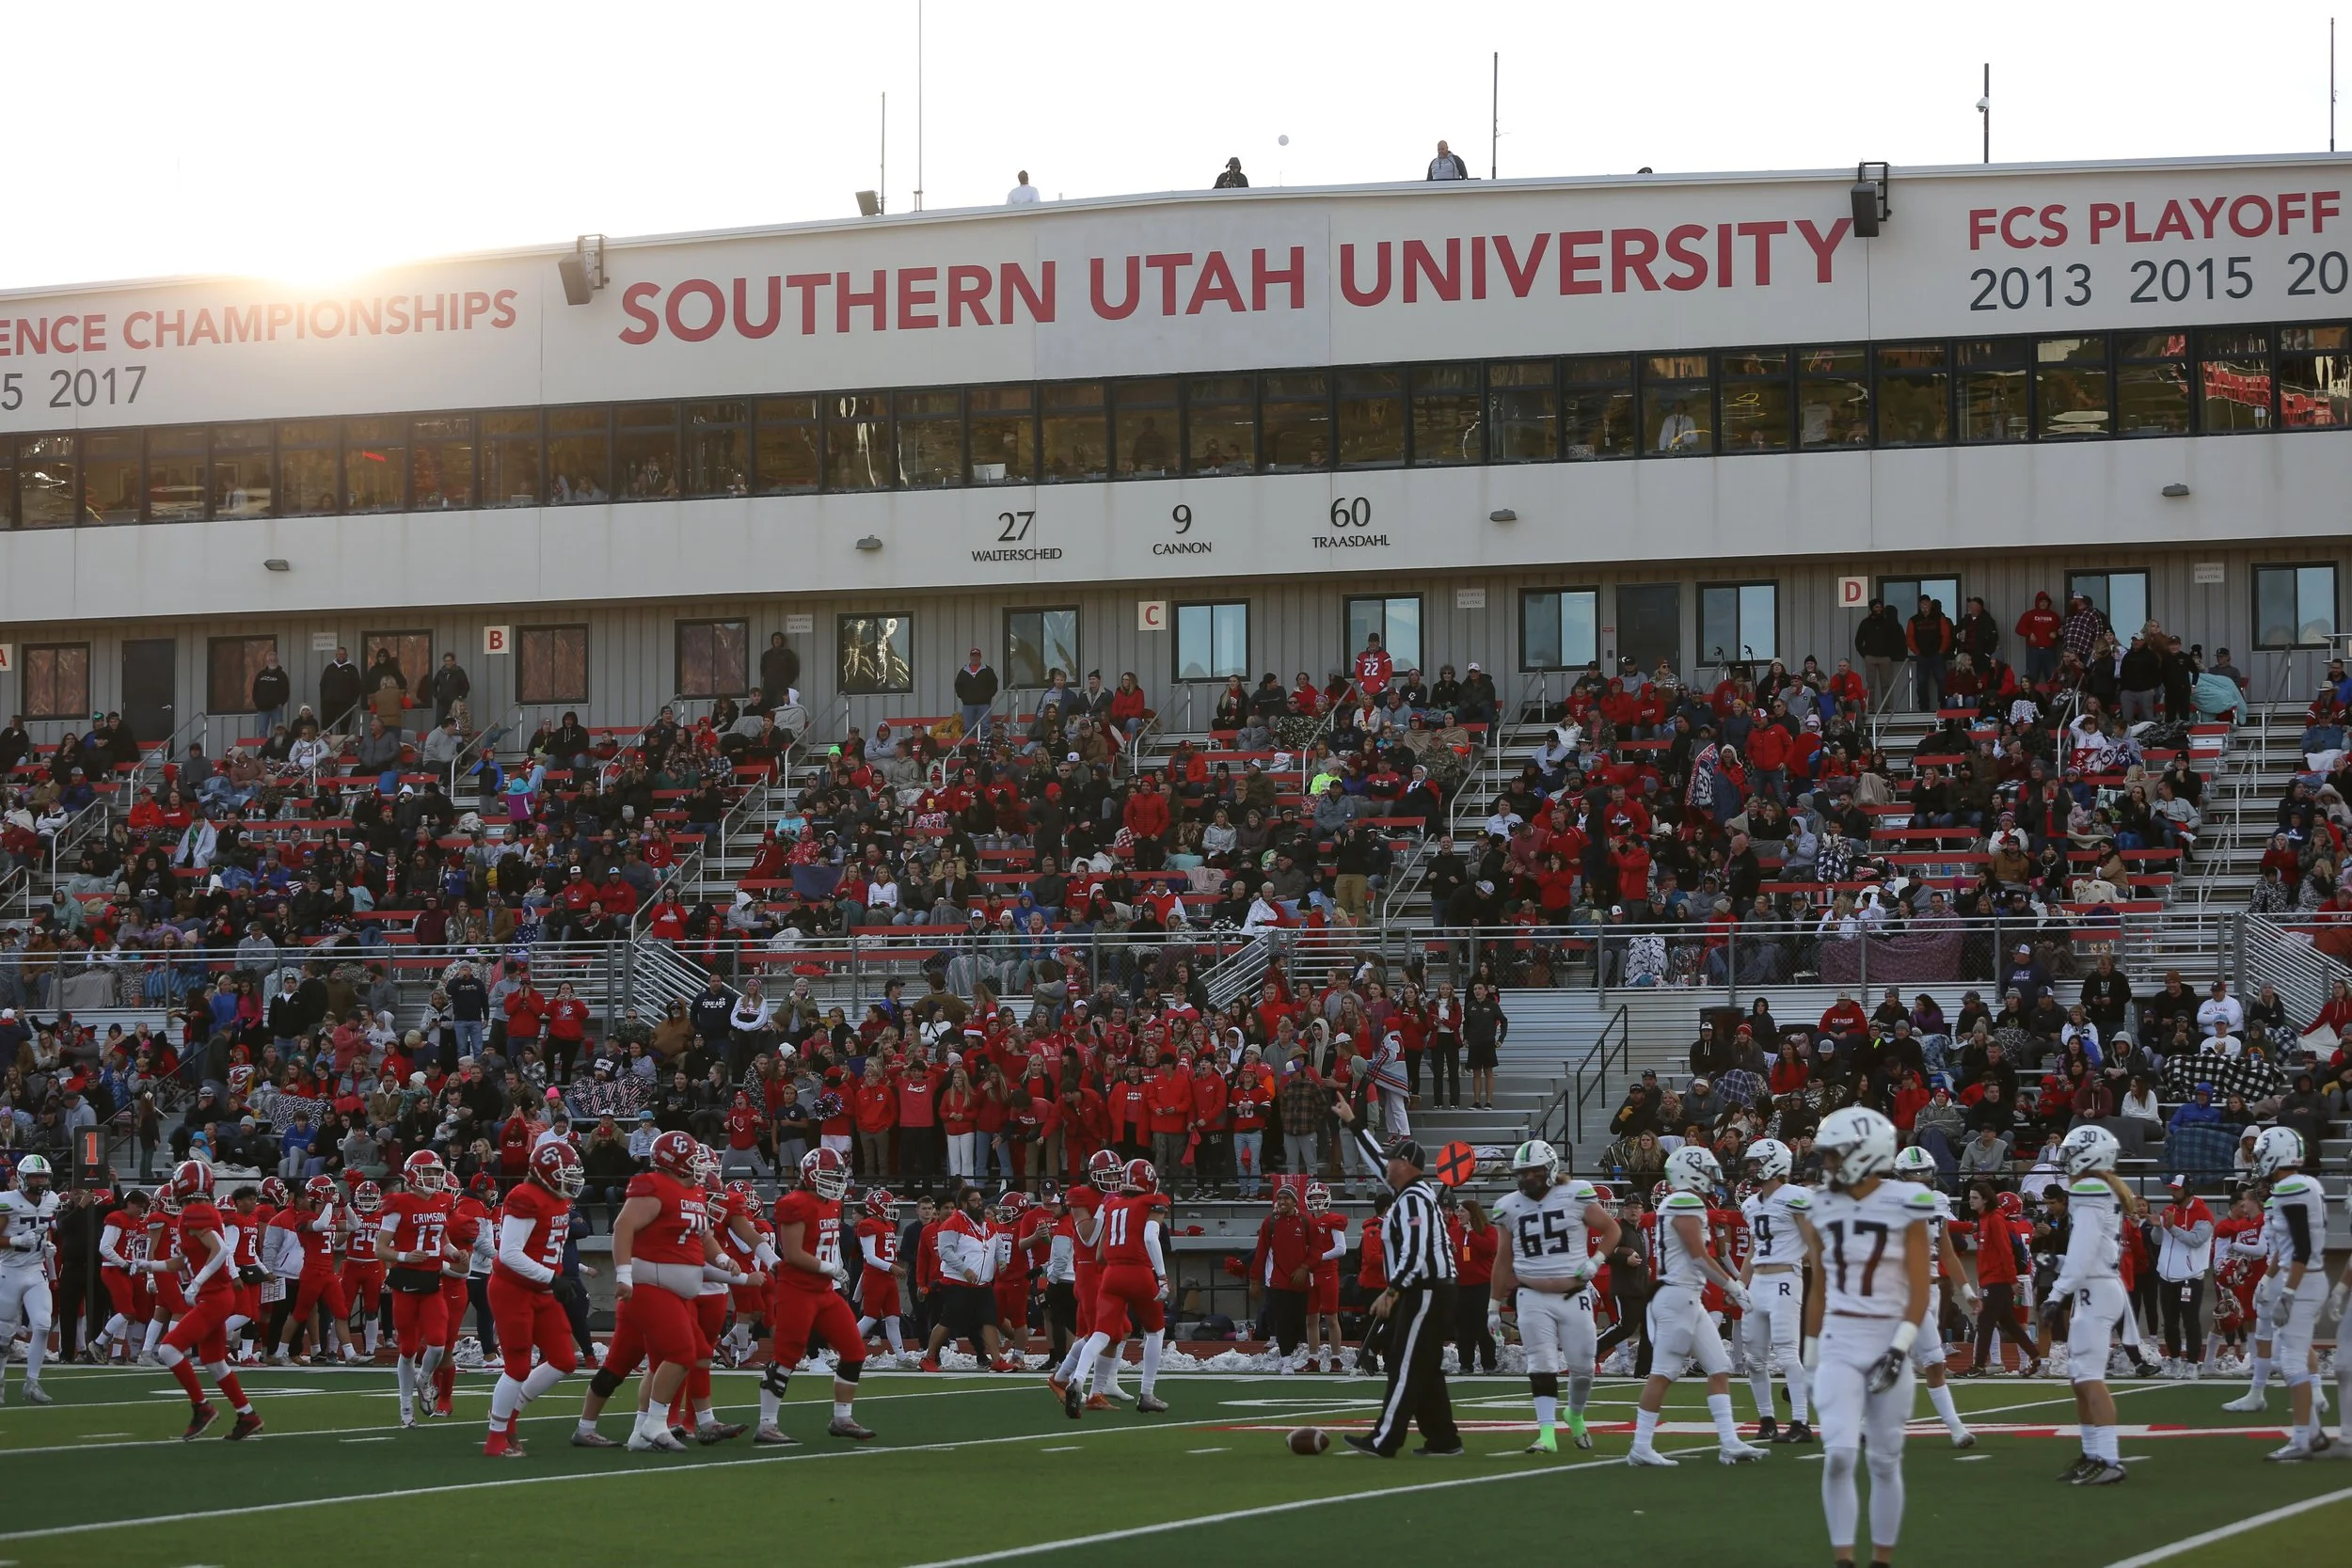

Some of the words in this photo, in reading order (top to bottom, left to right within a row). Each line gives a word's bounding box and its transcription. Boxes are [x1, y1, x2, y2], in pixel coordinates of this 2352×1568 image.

[1969, 203, 2069, 250] FCS
[2090, 190, 2341, 245] PLAYOFF
[617, 261, 1056, 345] SOUTHERN
[1089, 245, 1305, 321] UTAH
[1340, 217, 1853, 307] UNIVERSITY
[1970, 263, 2092, 311] 2013
[2129, 256, 2254, 304] 2015
[2287, 250, 2349, 296] 20
[123, 289, 518, 350] CHAMPIONSHIPS
[1, 372, 24, 411] 5
[49, 365, 147, 409] 2017
[1172, 504, 1192, 534] 9
[1329, 496, 1372, 528] 60
[997, 511, 1036, 542] 27
[1152, 541, 1212, 556] CANNON
[1311, 534, 1391, 549] TRAASDAHL
[972, 547, 1062, 562] WALTERSCHEID
[1845, 581, 1862, 602] D
[1145, 605, 1159, 626] C
[489, 630, 503, 650] B
[1363, 662, 1379, 676] 22
[1851, 1117, 1870, 1136] 17
[1766, 1141, 1775, 1151] 9
[2079, 1131, 2097, 1144] 30
[85, 1132, 99, 1165] 1
[1685, 1151, 1702, 1164] 23
[358, 1221, 381, 1230] RIMSON
[412, 1212, 448, 1225] CRIMSON
[1109, 1207, 1129, 1247] 11
[353, 1228, 379, 1252] 24
[416, 1224, 445, 1258] 13
[1518, 1209, 1570, 1259] 65
[1754, 1214, 1774, 1258] 9
[1828, 1221, 1889, 1298] 17
[1779, 1282, 1791, 1296] R
[2079, 1288, 2091, 1307] R
[1578, 1295, 1592, 1311] R
